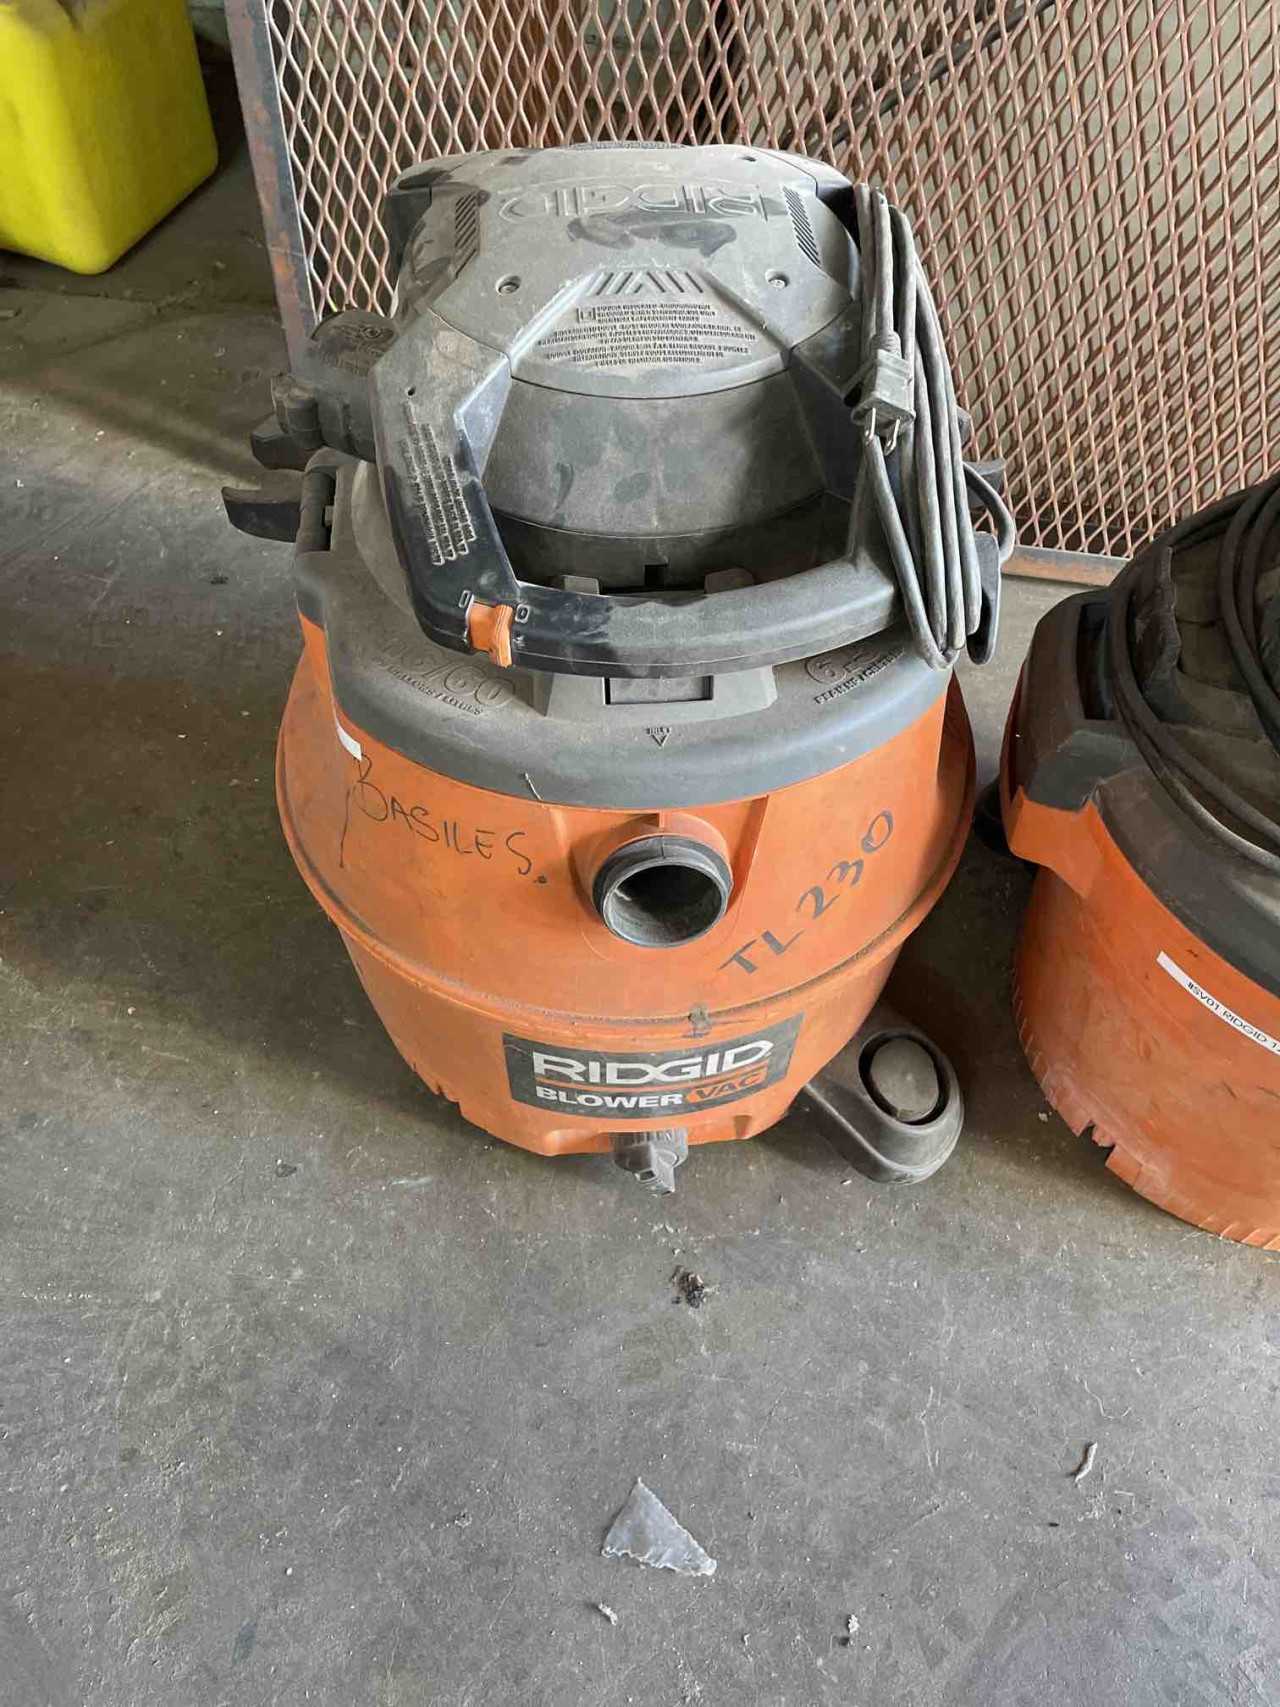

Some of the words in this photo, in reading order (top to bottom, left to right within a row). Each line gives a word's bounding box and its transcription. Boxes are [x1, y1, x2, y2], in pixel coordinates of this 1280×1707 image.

[499, 183, 768, 223] RIDGID
[1222, 1010, 1268, 1043] RIDGID
[532, 1039, 774, 1085] RIDGID
[535, 1086, 683, 1109] BLOWER
[694, 1069, 769, 1099] VAC
